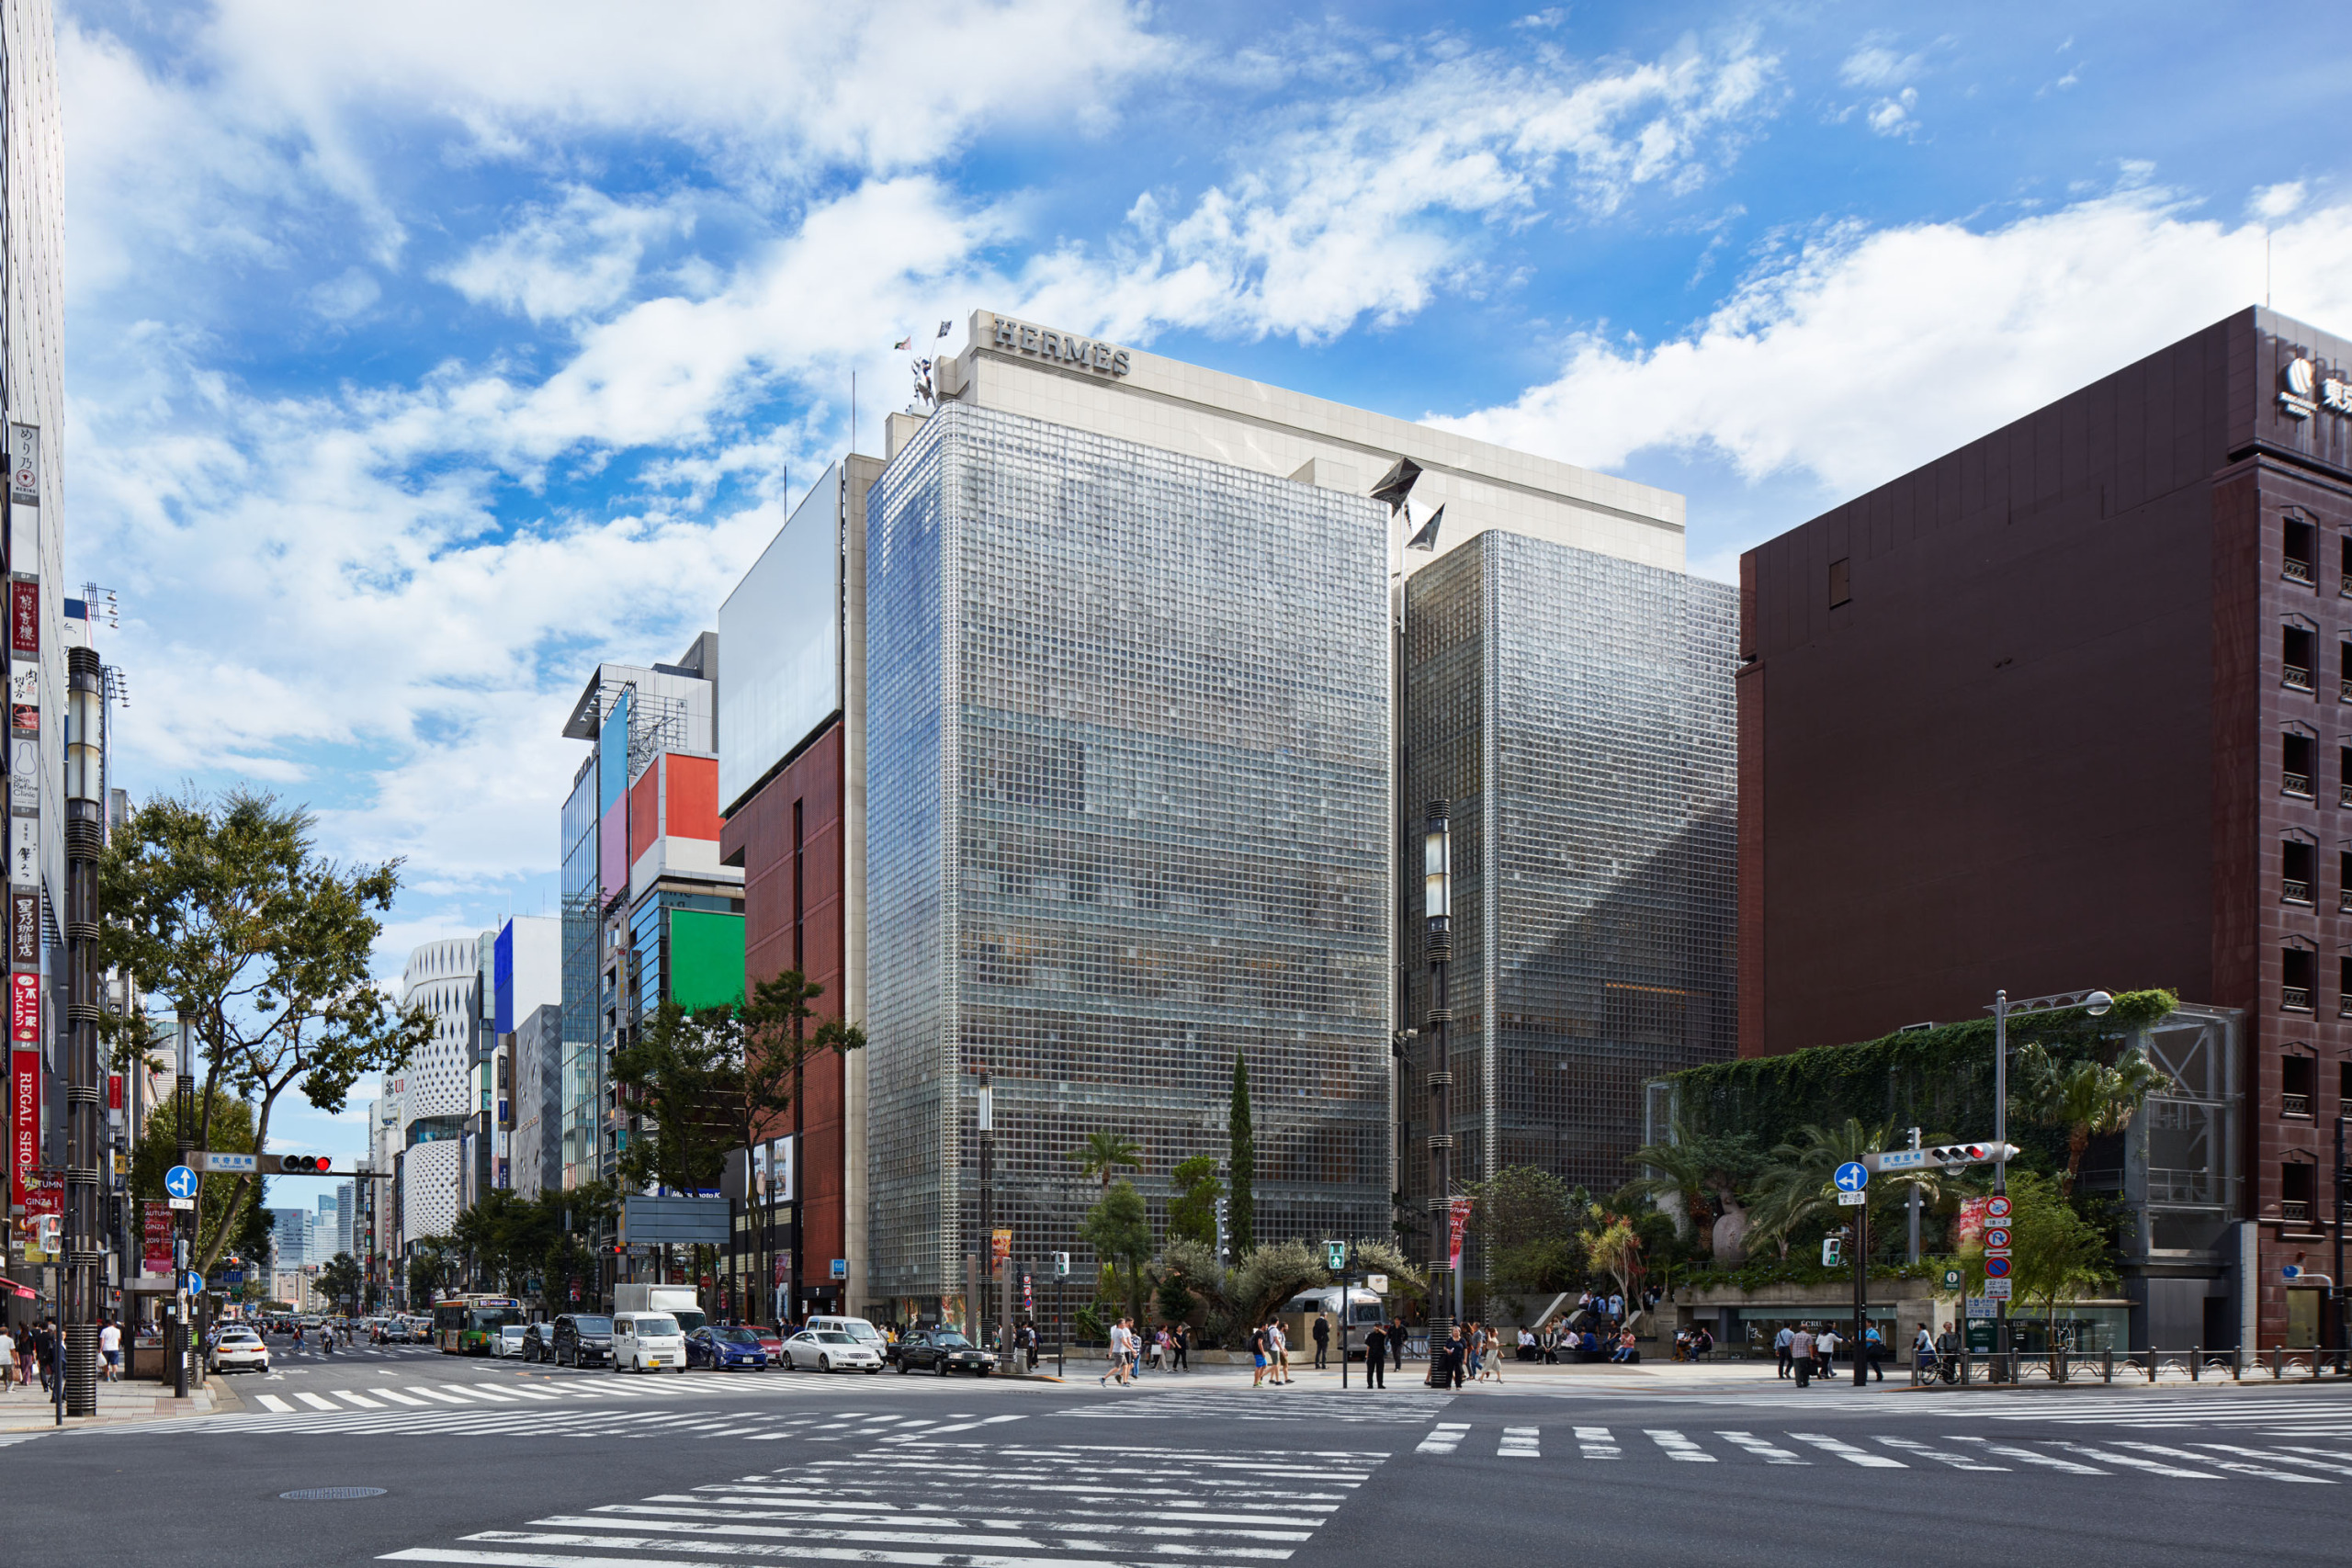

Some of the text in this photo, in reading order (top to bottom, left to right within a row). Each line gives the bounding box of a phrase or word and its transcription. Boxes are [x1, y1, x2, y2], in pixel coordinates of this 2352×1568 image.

[994, 318, 1131, 376] HERMÈS
[20, 428, 33, 469] めり乃
[14, 774, 30, 784] Skin
[14, 782, 39, 791] Refine
[14, 789, 36, 798] Clinic
[17, 898, 34, 958] 星乃珈琲店
[16, 987, 24, 1026] レストラン
[25, 987, 37, 1027] 不二家
[19, 1071, 32, 1126] REGAL
[25, 1180, 62, 1189] AUTUMN
[26, 1198, 52, 1206] GINZA
